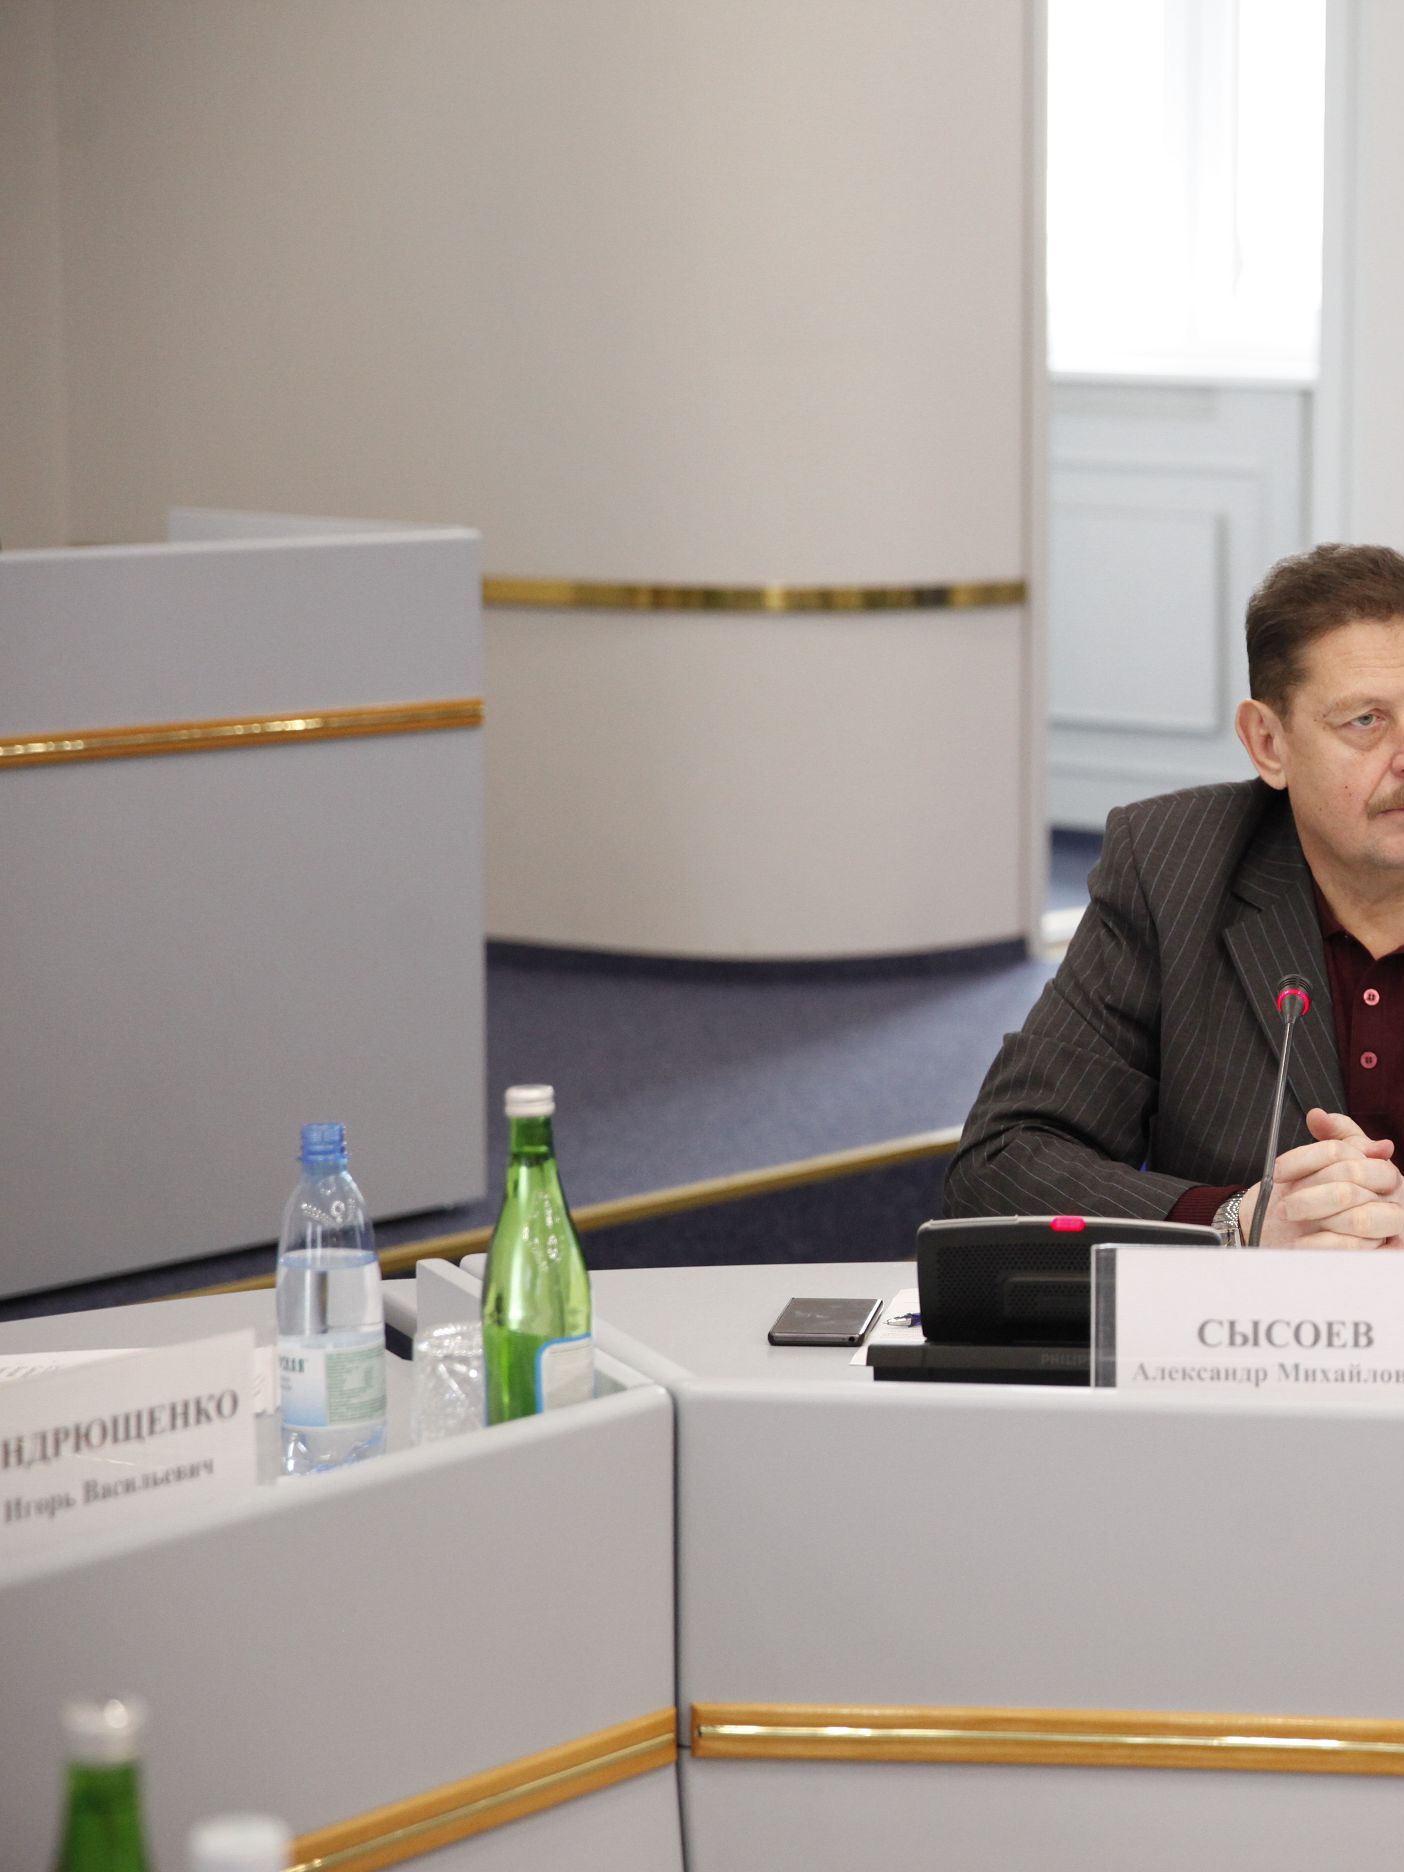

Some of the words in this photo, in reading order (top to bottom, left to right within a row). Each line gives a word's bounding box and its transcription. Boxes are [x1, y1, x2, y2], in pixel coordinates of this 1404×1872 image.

[1196, 1318, 1376, 1350] СЫСОЕВ
[1040, 1353, 1089, 1366] PHILIP
[1131, 1362, 1268, 1387] Александр
[0, 1389, 240, 1470] НДРЮЩЕНКО
[4, 1491, 77, 1523] Игорь
[82, 1458, 215, 1505] Васильевич
